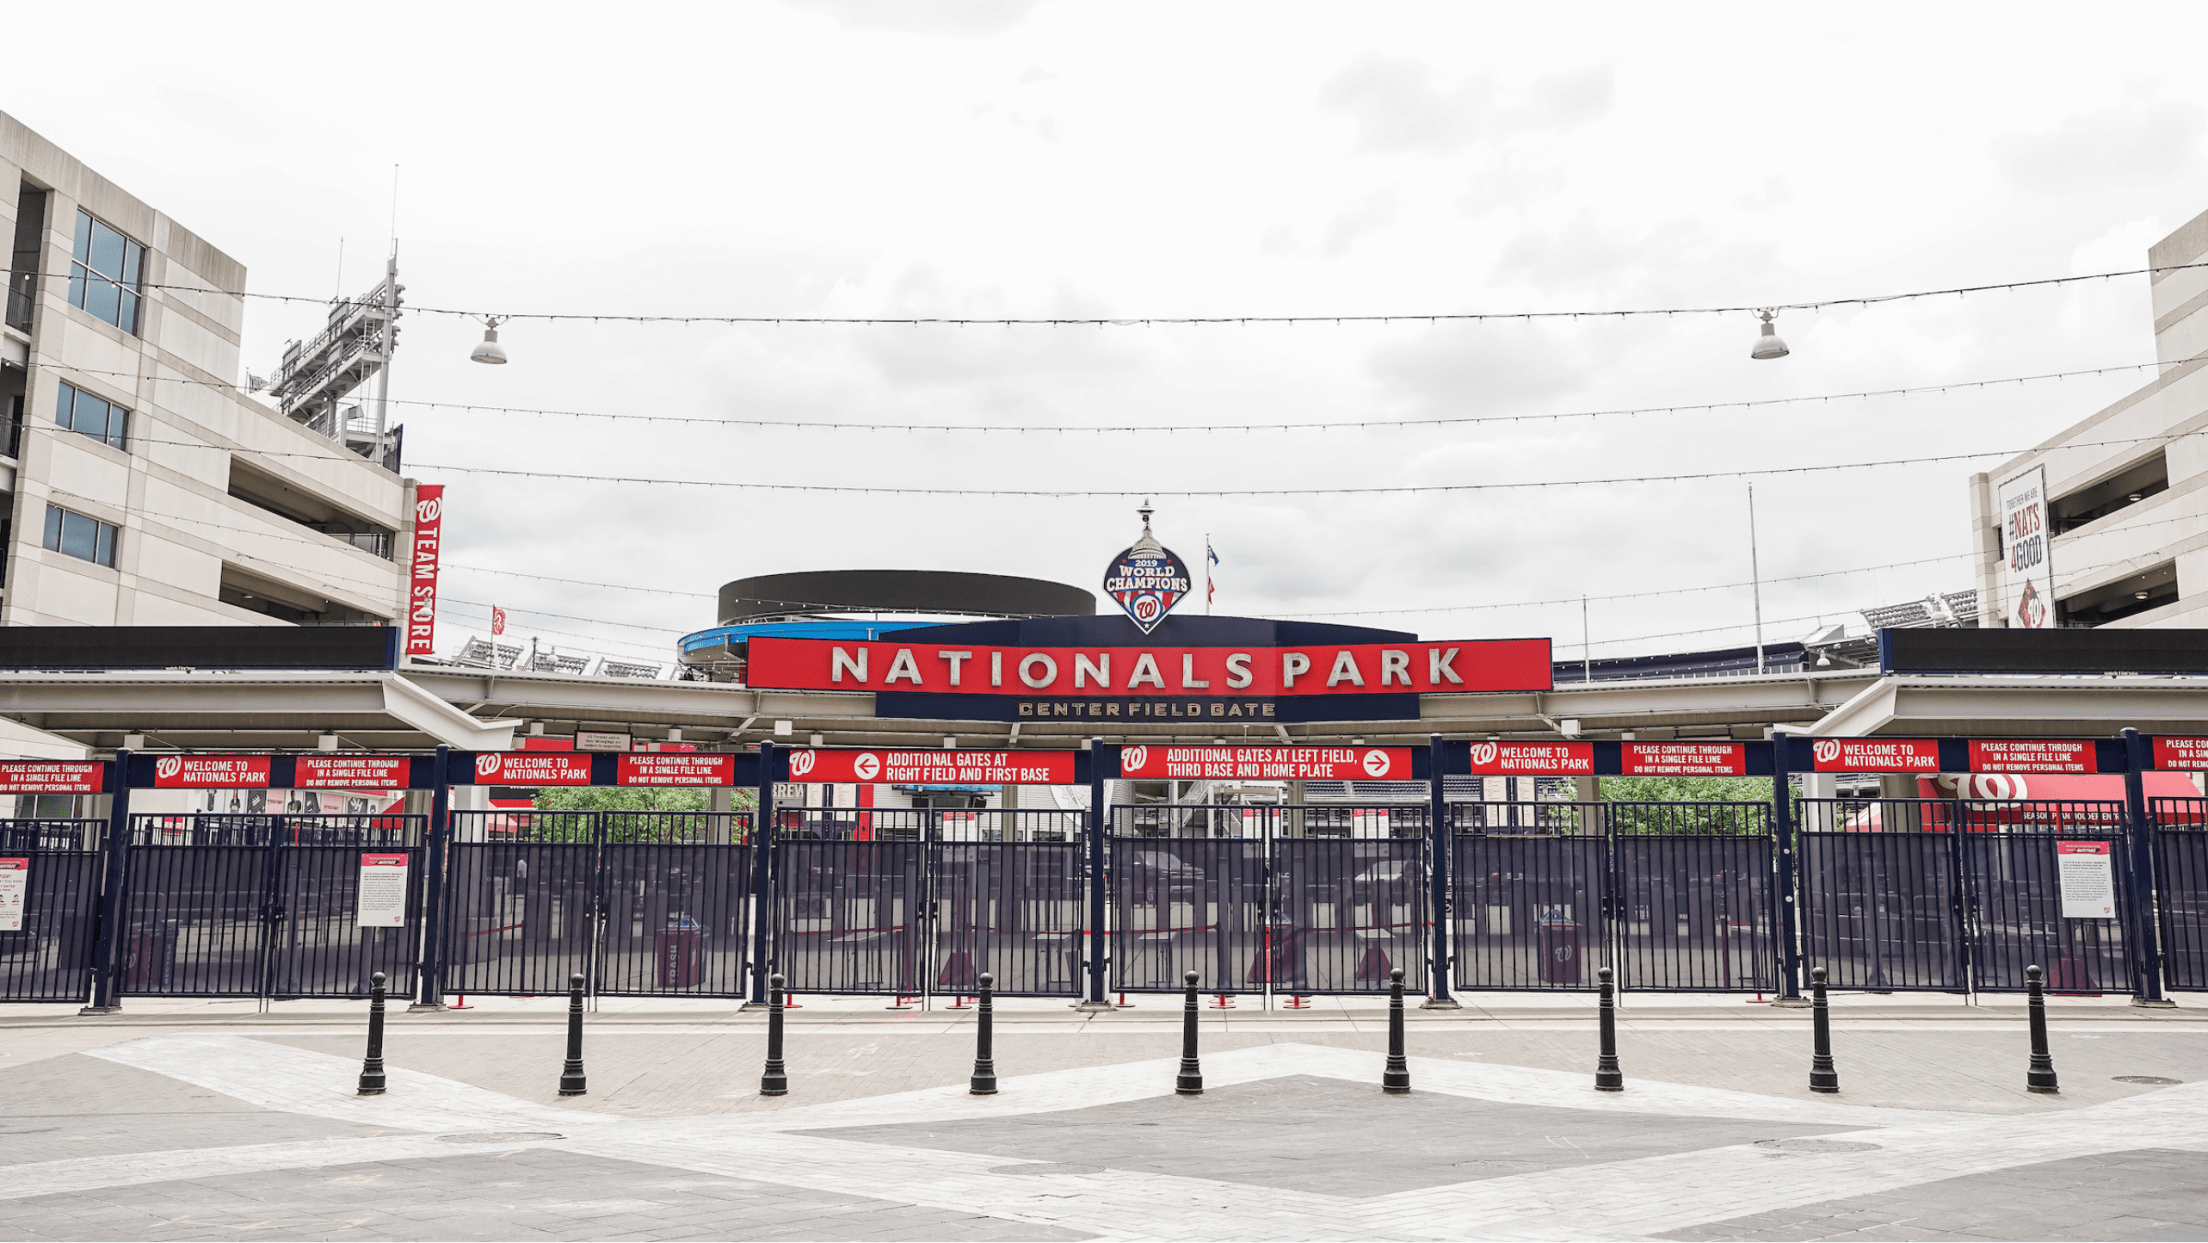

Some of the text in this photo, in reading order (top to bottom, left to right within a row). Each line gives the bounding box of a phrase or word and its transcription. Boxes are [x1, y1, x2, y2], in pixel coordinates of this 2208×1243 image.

[2024, 490, 2030, 502] WE
[2009, 502, 2040, 542] #NATS
[2012, 534, 2042, 573] 4GOOD
[1119, 565, 1175, 577] WORLD
[410, 528, 437, 649] TEAM STORE
[1106, 578, 1188, 592] CHAMPIONS
[832, 647, 1464, 688] NATIONALS PARK
[1018, 703, 1276, 716] CENTER FIELD GATE
[1844, 744, 1914, 755] WELCOME TO
[1981, 743, 2082, 752] PLEASE CONTINUE THROUGH
[2166, 740, 2208, 748] PLEASE CO
[1500, 747, 1568, 758] WELCOME TO
[1634, 746, 1732, 754] PLEASE CONTINUE THROUGH
[2179, 750, 2187, 758] IN
[2189, 750, 2194, 758] A
[630, 757, 722, 765] PLEASE CONTINUE THROUGH
[886, 753, 1007, 766] ADDITIONAL GATES AT
[1167, 749, 1357, 765] ADDITIONAL GATES AT LEFT FIELD,
[1645, 755, 1721, 763] IN A SINGLE FILE LINE
[1845, 756, 1935, 766] NATIONALS PARK
[1993, 753, 2072, 761] IN A SINGLE FILE LINE
[184, 761, 248, 771] WELCOME TO
[308, 760, 399, 768] PLEASE CONTINUE THROUGH
[504, 758, 568, 768] WELCOME TO
[1501, 758, 1589, 769] NATIONALS PARK
[503, 769, 587, 779] NATIONALS PARK
[640, 766, 712, 774] IN A SINGLE FILE LINE
[887, 768, 1049, 781] RIGHT FIELD AND FIRST BASE
[1167, 763, 1333, 777] THIRD BASE AND HOME PLATE
[183, 772, 266, 782] NATIONALS PARK
[773, 784, 803, 798] BREW
